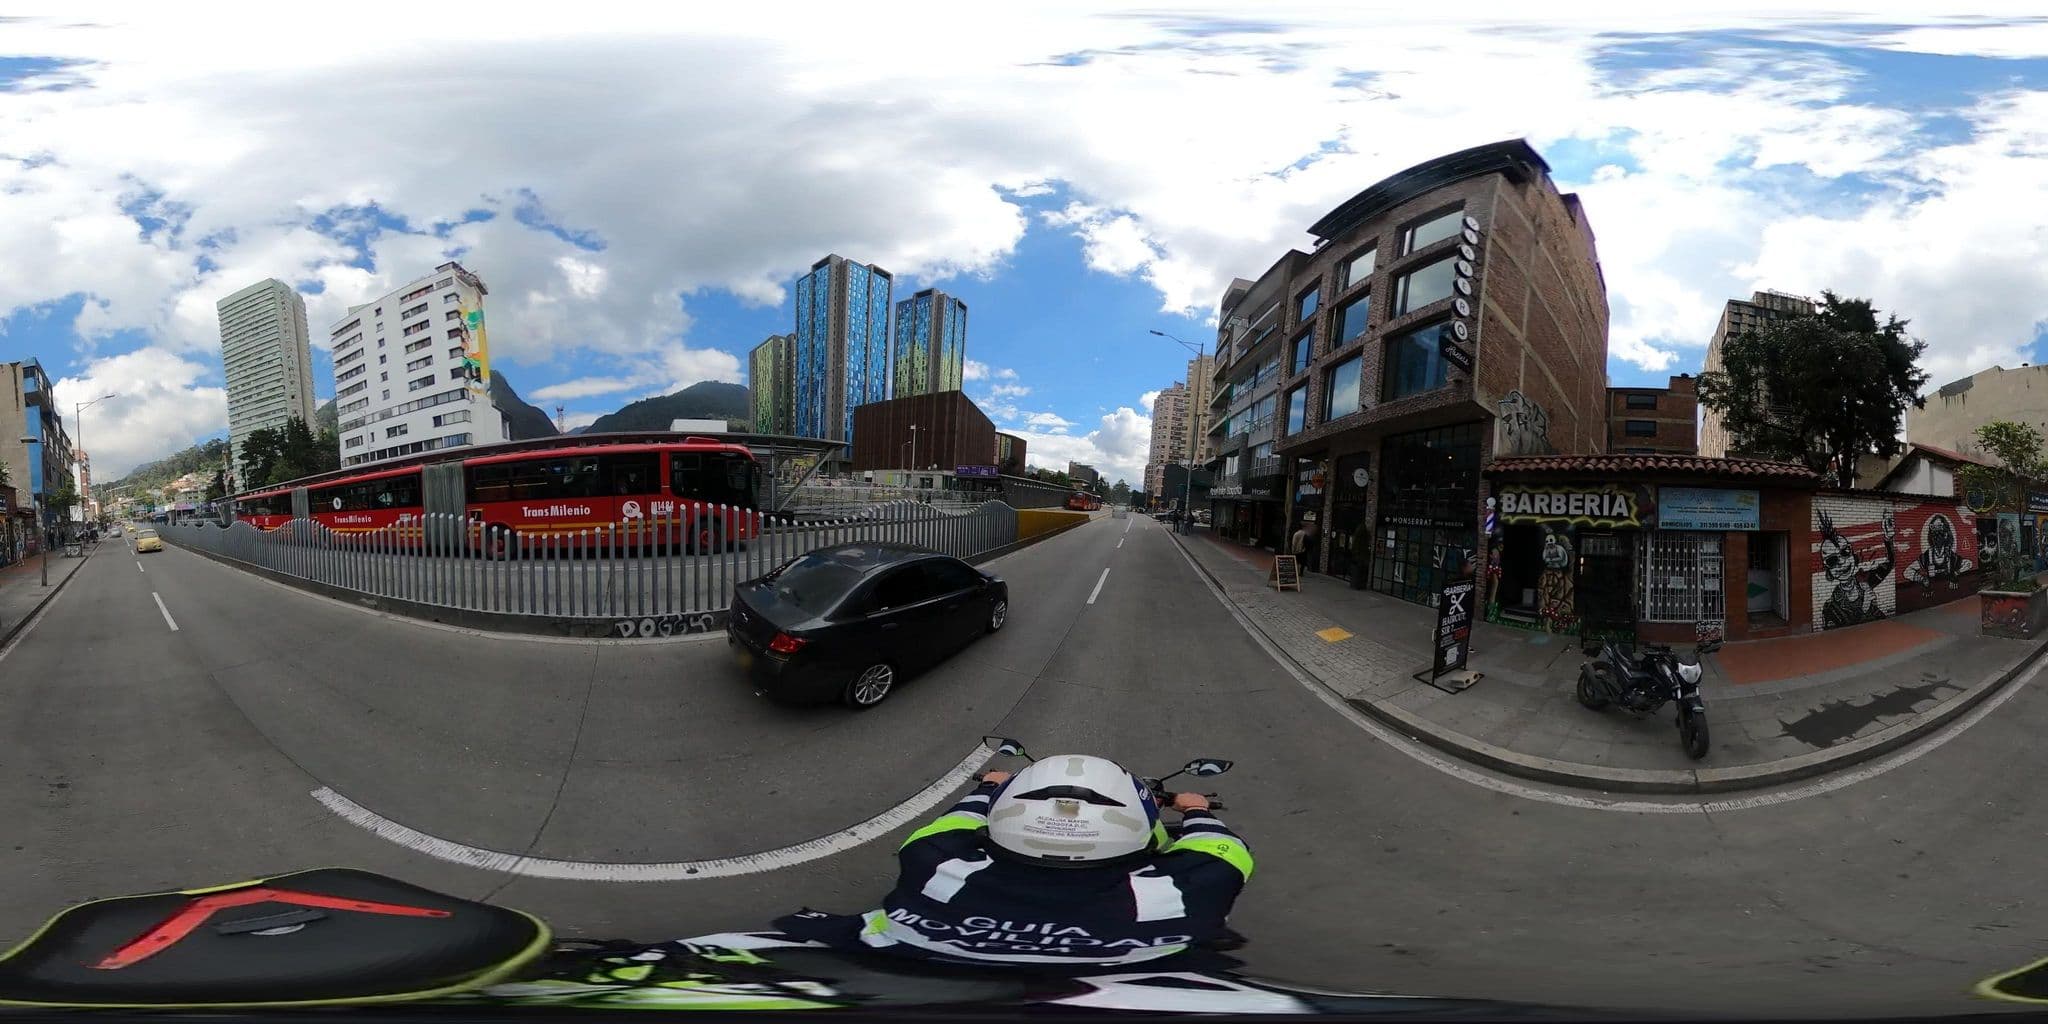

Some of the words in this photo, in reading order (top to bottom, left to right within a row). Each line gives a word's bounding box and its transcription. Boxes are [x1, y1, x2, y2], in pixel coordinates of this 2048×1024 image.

[1455, 218, 1479, 339] VIAJERO
[1502, 489, 1629, 517] BARBERÍA
[887, 907, 1194, 948] MOVILIDAD
